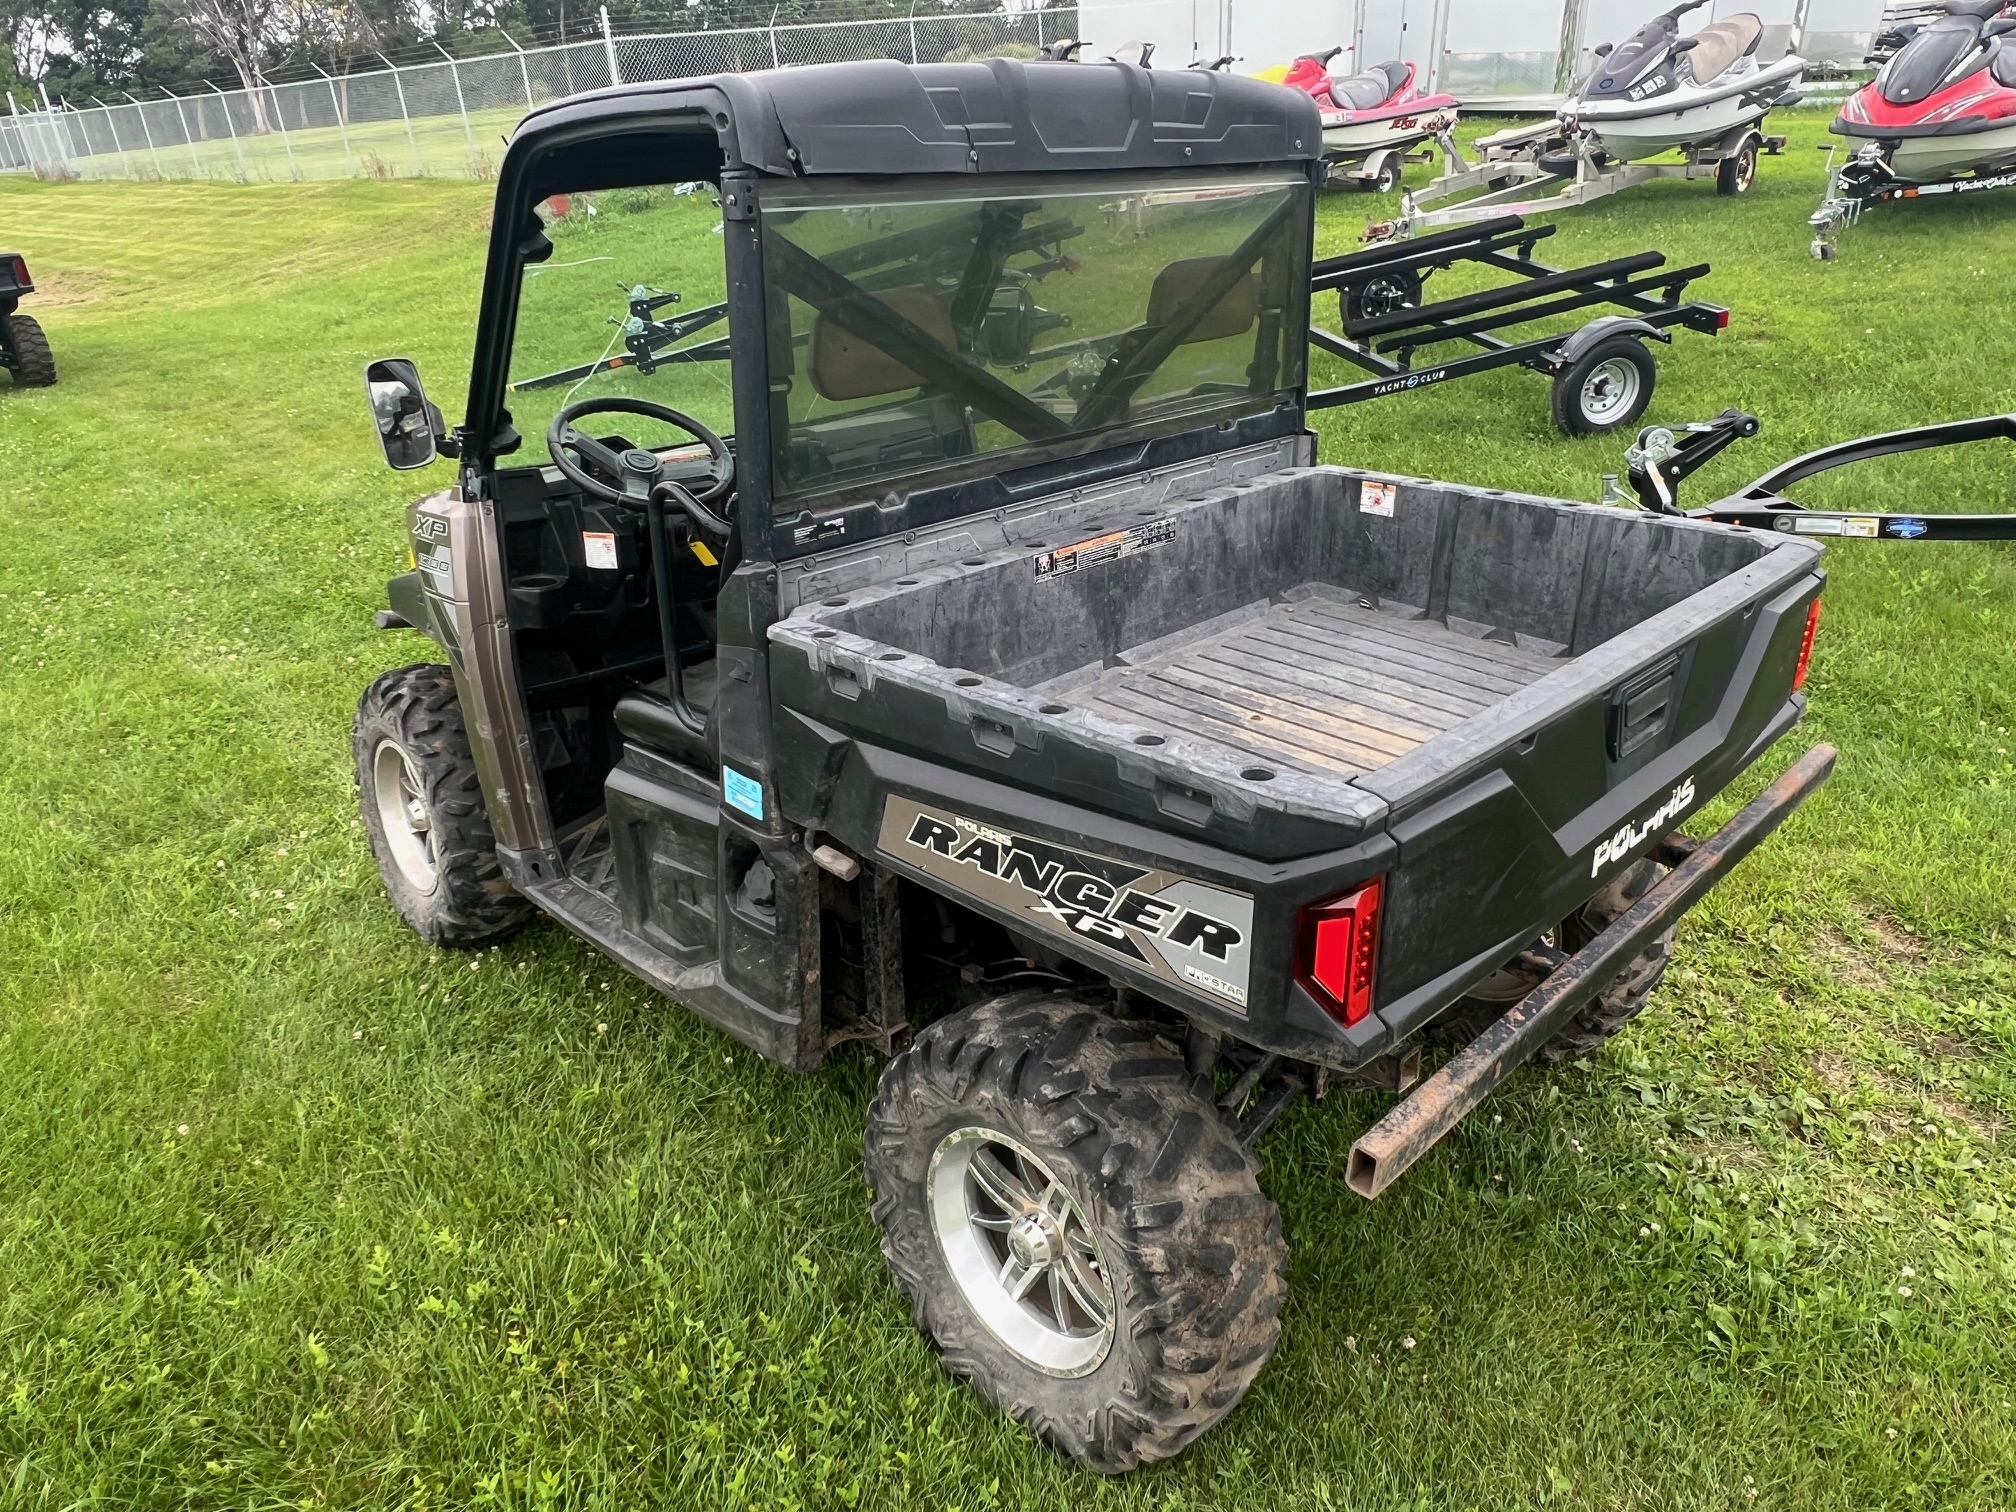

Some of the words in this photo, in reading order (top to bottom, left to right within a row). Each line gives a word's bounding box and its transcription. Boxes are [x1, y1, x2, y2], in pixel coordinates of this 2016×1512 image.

[1374, 380, 1406, 394] YACHT
[1420, 370, 1446, 383] CLUB
[411, 513, 448, 539] XP
[954, 816, 1013, 847] POLARIS
[1591, 775, 1696, 879] POLARIS
[905, 813, 1244, 964] RANGER
[1031, 900, 1125, 940] XP
[1185, 965, 1244, 998] STAR
